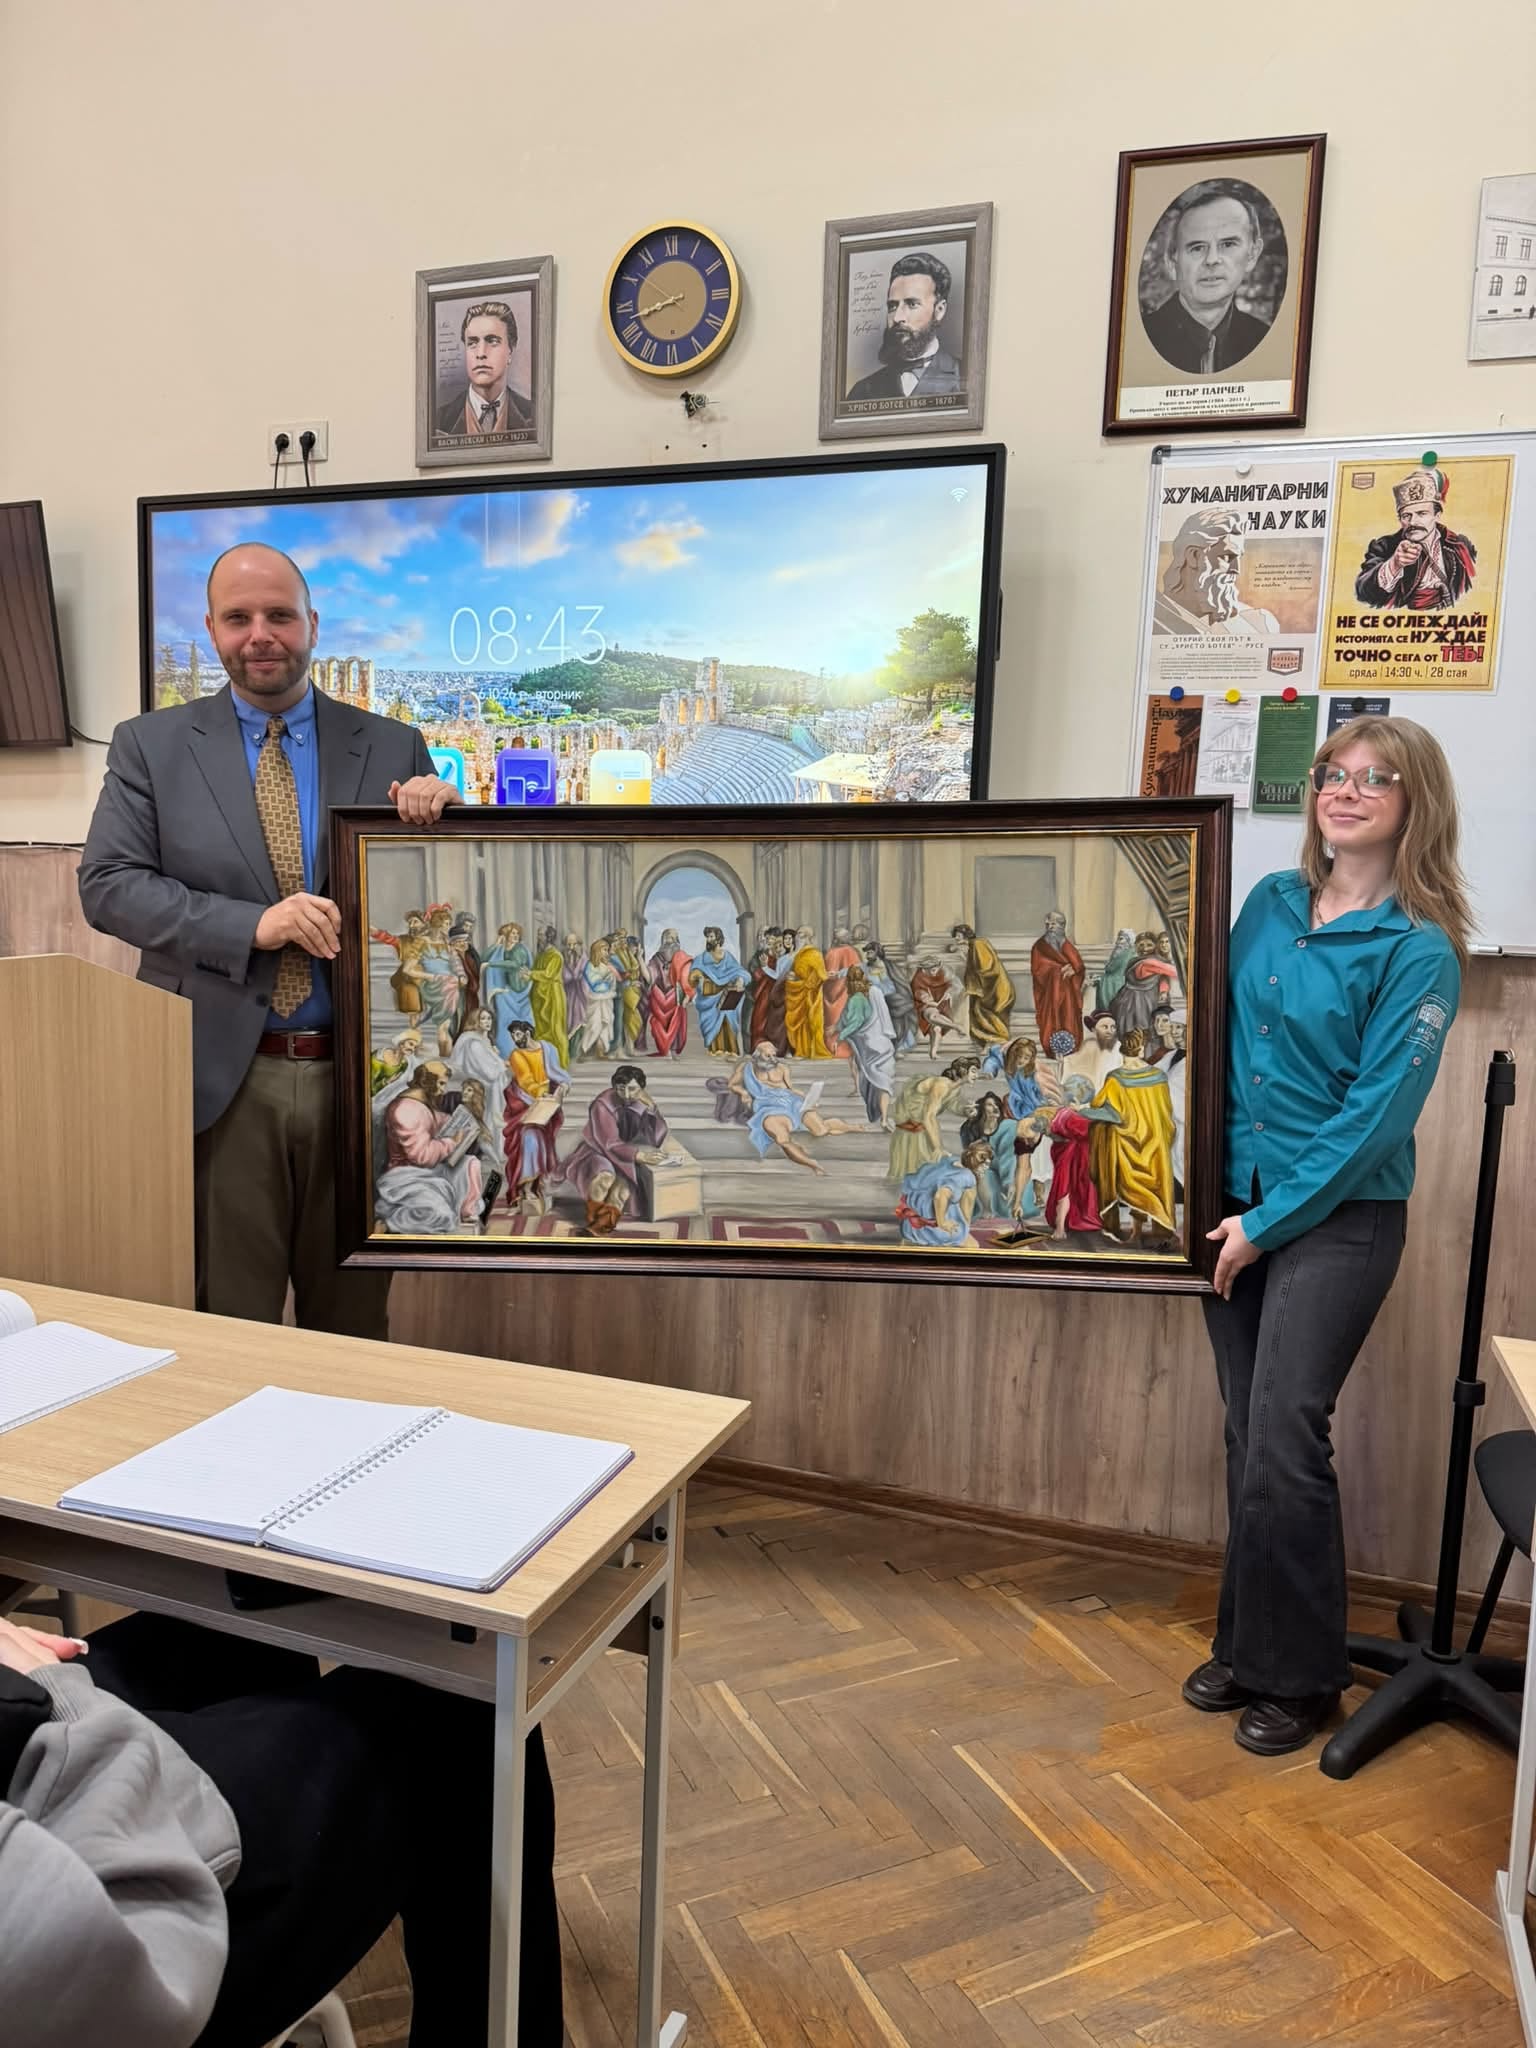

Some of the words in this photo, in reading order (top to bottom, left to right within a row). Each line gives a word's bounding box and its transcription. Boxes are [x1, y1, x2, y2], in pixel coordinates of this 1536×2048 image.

[664, 235, 678, 257] XII
[637, 247, 655, 268] XI
[705, 258, 723, 276] II
[711, 288, 729, 300] III
[616, 300, 633, 313] IX
[705, 313, 723, 332] IV
[666, 344, 679, 365] VI
[1165, 388, 1199, 397] ПЕТЪР
[1202, 385, 1245, 396] ПАНЧЕВ
[848, 403, 878, 412] ХРИСТО
[880, 400, 904, 410] БОТЕВ
[1162, 482, 1328, 504] ХУМАНИТАРНИ
[1248, 510, 1327, 530] НАУКИ
[1337, 615, 1355, 628] НЕ
[1360, 615, 1379, 628] СЕ
[1383, 612, 1488, 630] ОГЛЕЖДАЙ!
[450, 605, 607, 665] 08:43
[1335, 635, 1394, 644] ИСТОРИЯТА
[1396, 635, 1409, 643] СЕ
[1410, 630, 1486, 646] НУЖДАЕ
[1334, 650, 1391, 663] ТОЧНО
[1394, 653, 1420, 662] СЕГА
[1424, 653, 1438, 662] ОТ
[1440, 645, 1485, 662] ТЕБ!
[1349, 668, 1377, 678] сряда
[1385, 667, 1412, 677] 14:30
[1414, 669, 1422, 677] ч.
[1430, 667, 1444, 677] 28
[1446, 668, 1468, 677] стая
[535, 690, 582, 700] вторник
